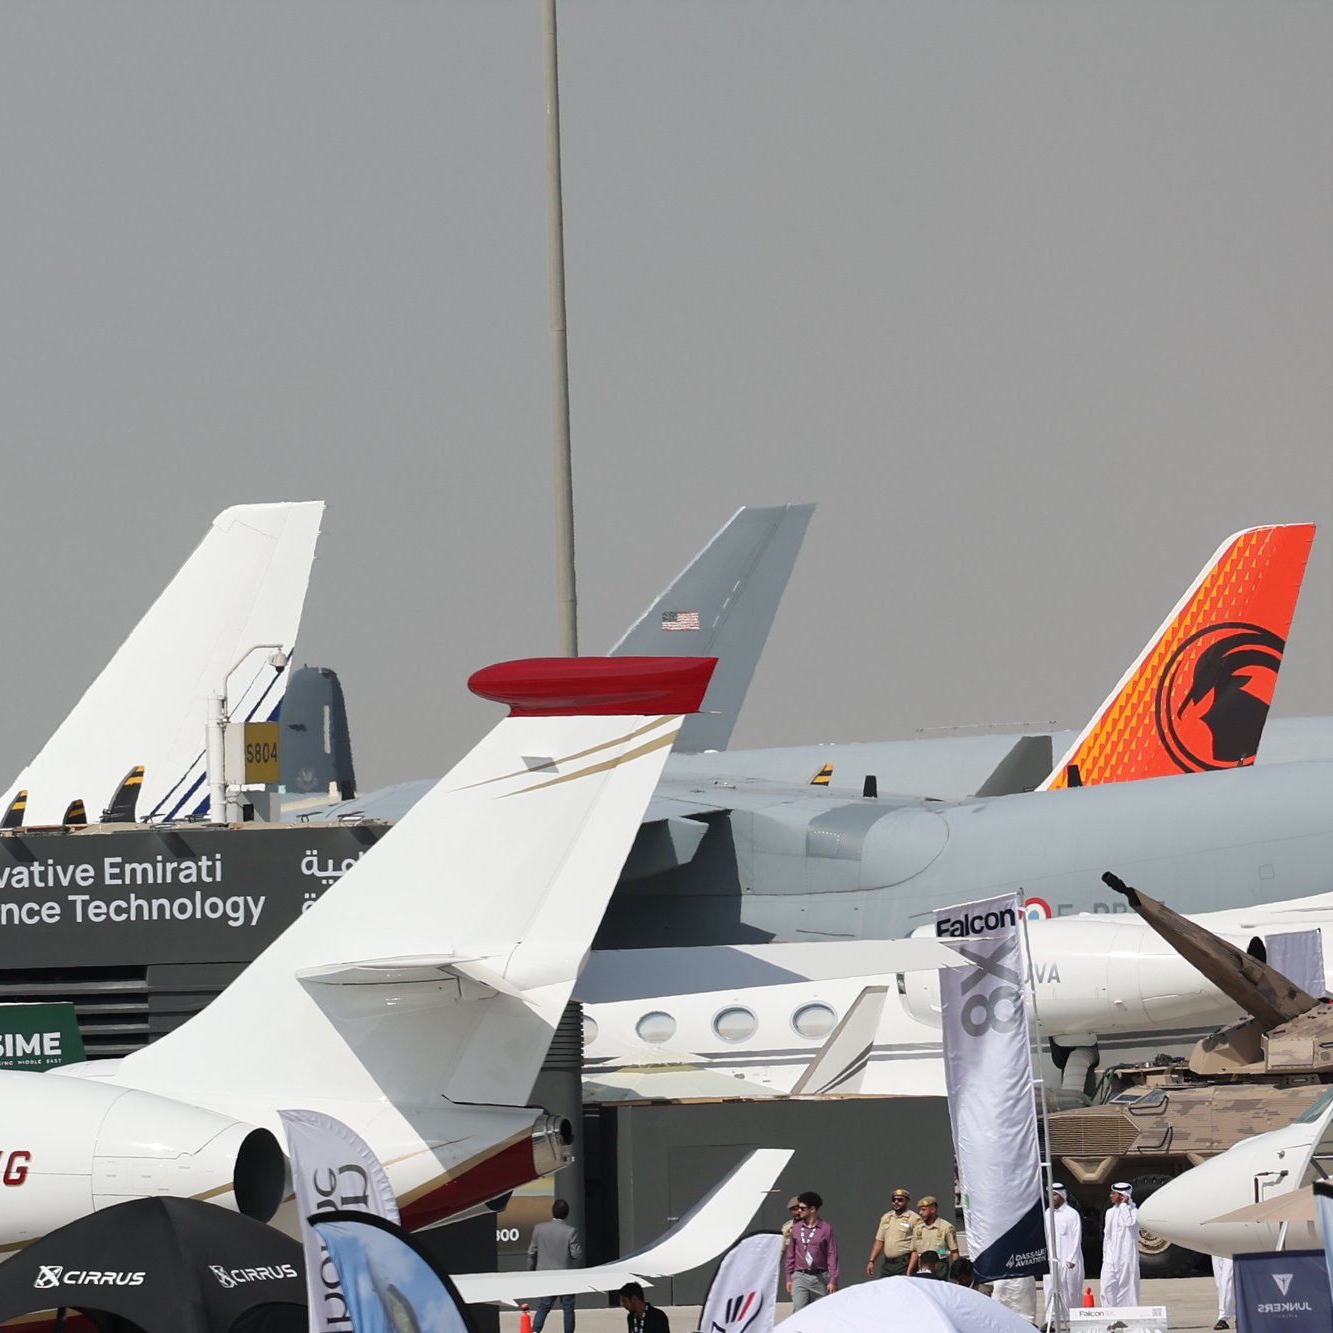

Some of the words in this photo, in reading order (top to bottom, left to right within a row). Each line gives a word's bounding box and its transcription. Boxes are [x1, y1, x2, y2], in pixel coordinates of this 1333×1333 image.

[247, 743, 278, 763] S804
[104, 853, 223, 885] Emirati
[67, 892, 266, 926] Technology
[935, 907, 1017, 938] Falcon
[62, 1270, 146, 1286] CIRRUS
[233, 1264, 298, 1284] CIRRUS
